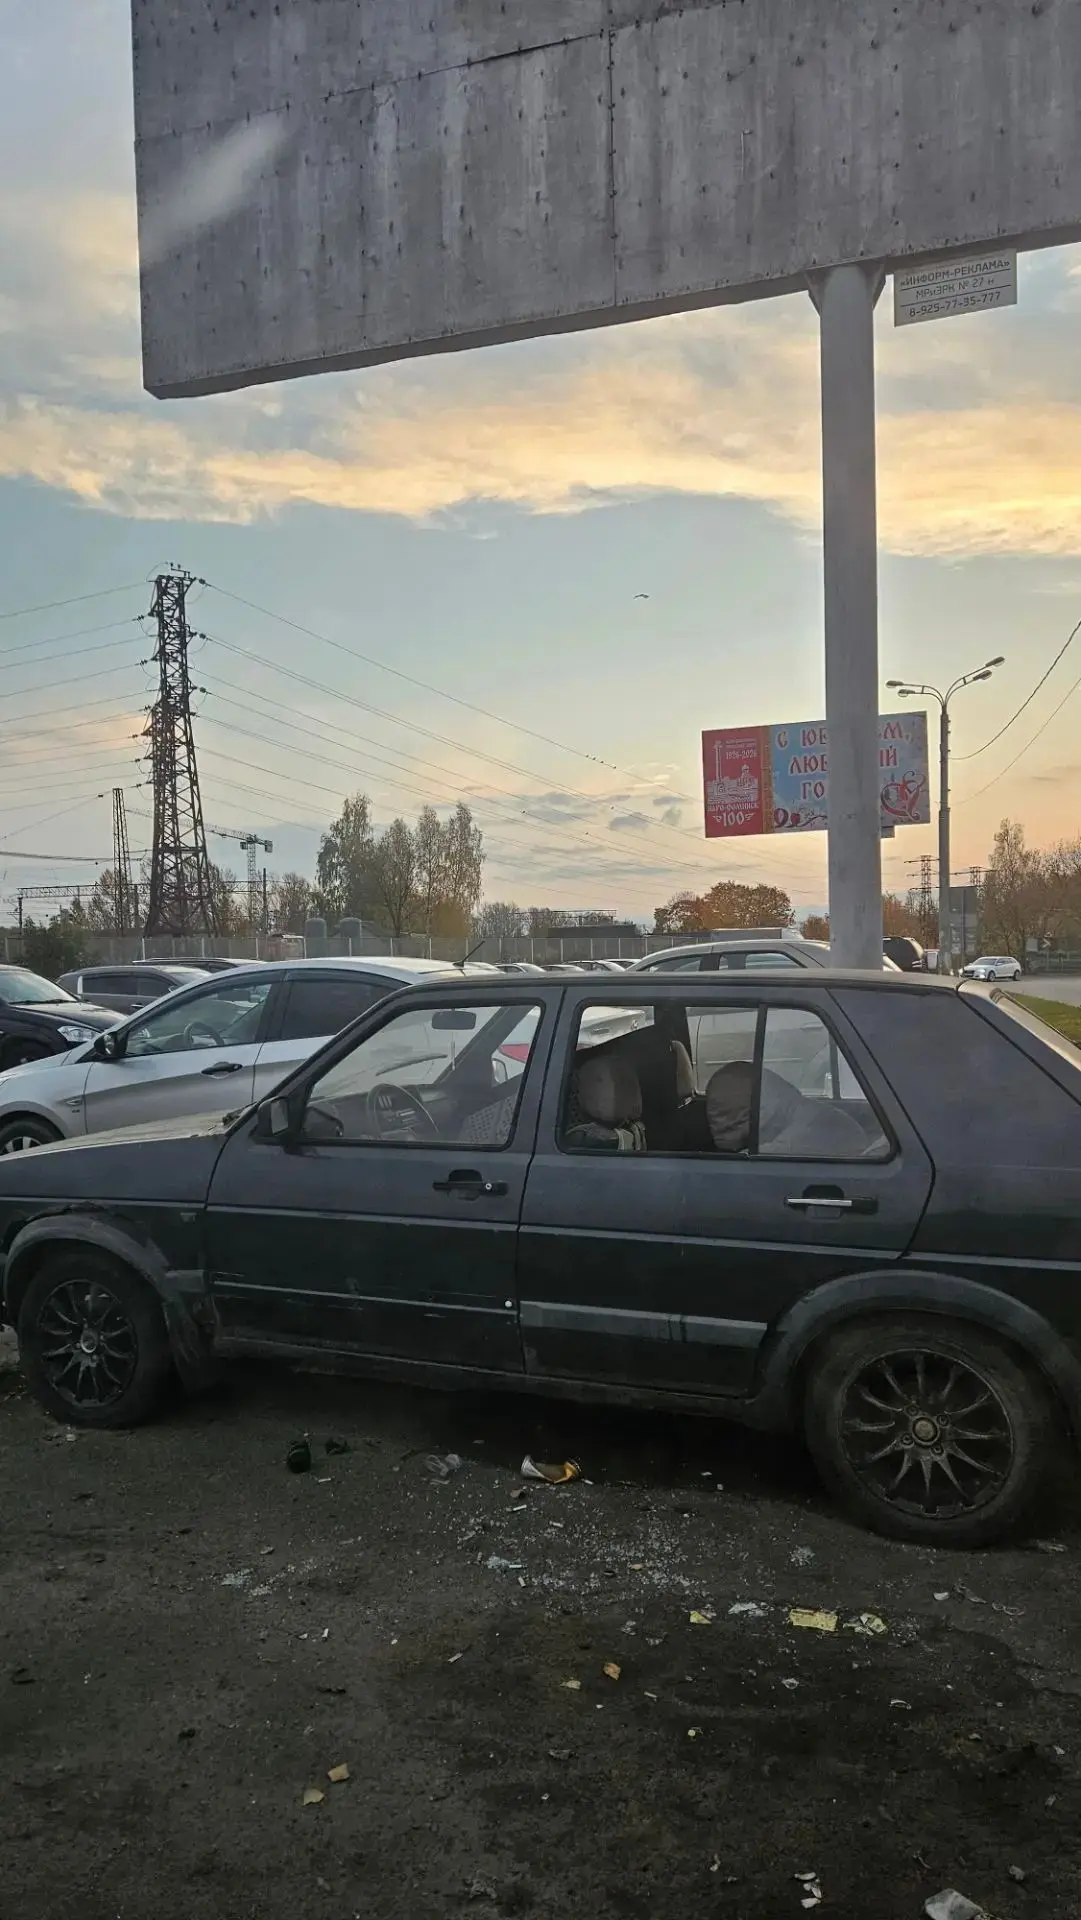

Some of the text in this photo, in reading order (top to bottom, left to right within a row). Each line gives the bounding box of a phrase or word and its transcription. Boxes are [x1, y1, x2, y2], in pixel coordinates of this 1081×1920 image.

[901, 260, 1010, 286] «ИНФОРМ-РЕКЛАМА»
[972, 277, 984, 288] 27
[909, 291, 1001, 317] 8-925-77-35-777
[776, 730, 789, 749] С
[723, 811, 745, 827] 100
